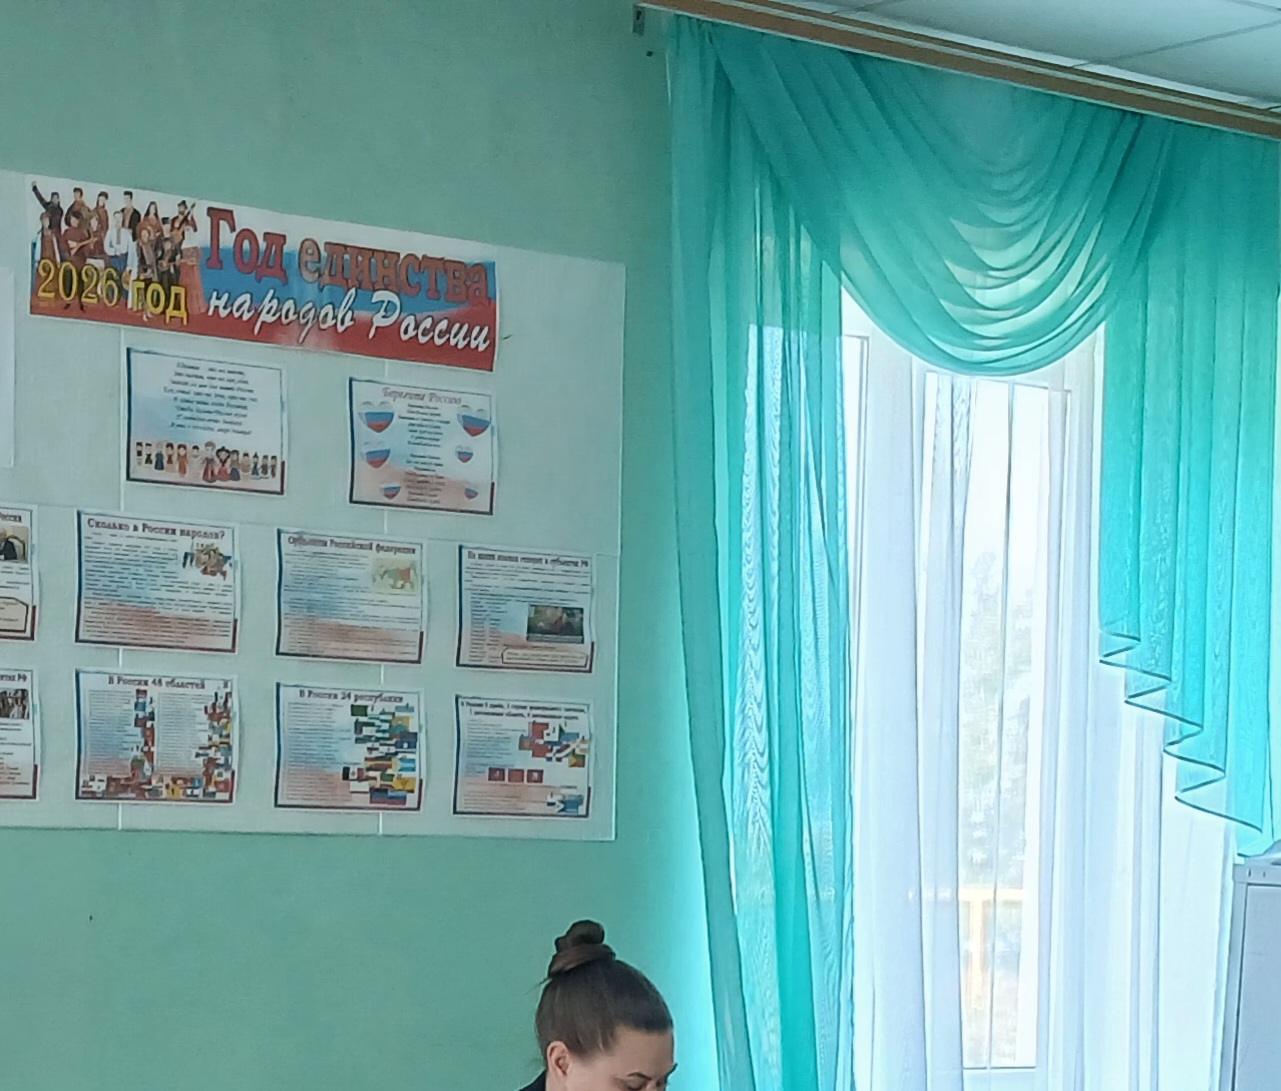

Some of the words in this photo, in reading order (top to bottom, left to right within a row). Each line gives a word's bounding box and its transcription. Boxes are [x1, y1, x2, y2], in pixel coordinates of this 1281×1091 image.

[206, 207, 287, 283] Год
[297, 238, 493, 304] единства
[37, 258, 118, 308] 2026
[131, 279, 188, 326] год
[207, 288, 355, 338] народов
[368, 290, 492, 352] России
[87, 518, 130, 532] Сколько
[132, 524, 139, 532] в
[142, 522, 177, 536] России
[179, 528, 226, 543] народов?
[117, 675, 149, 687] России
